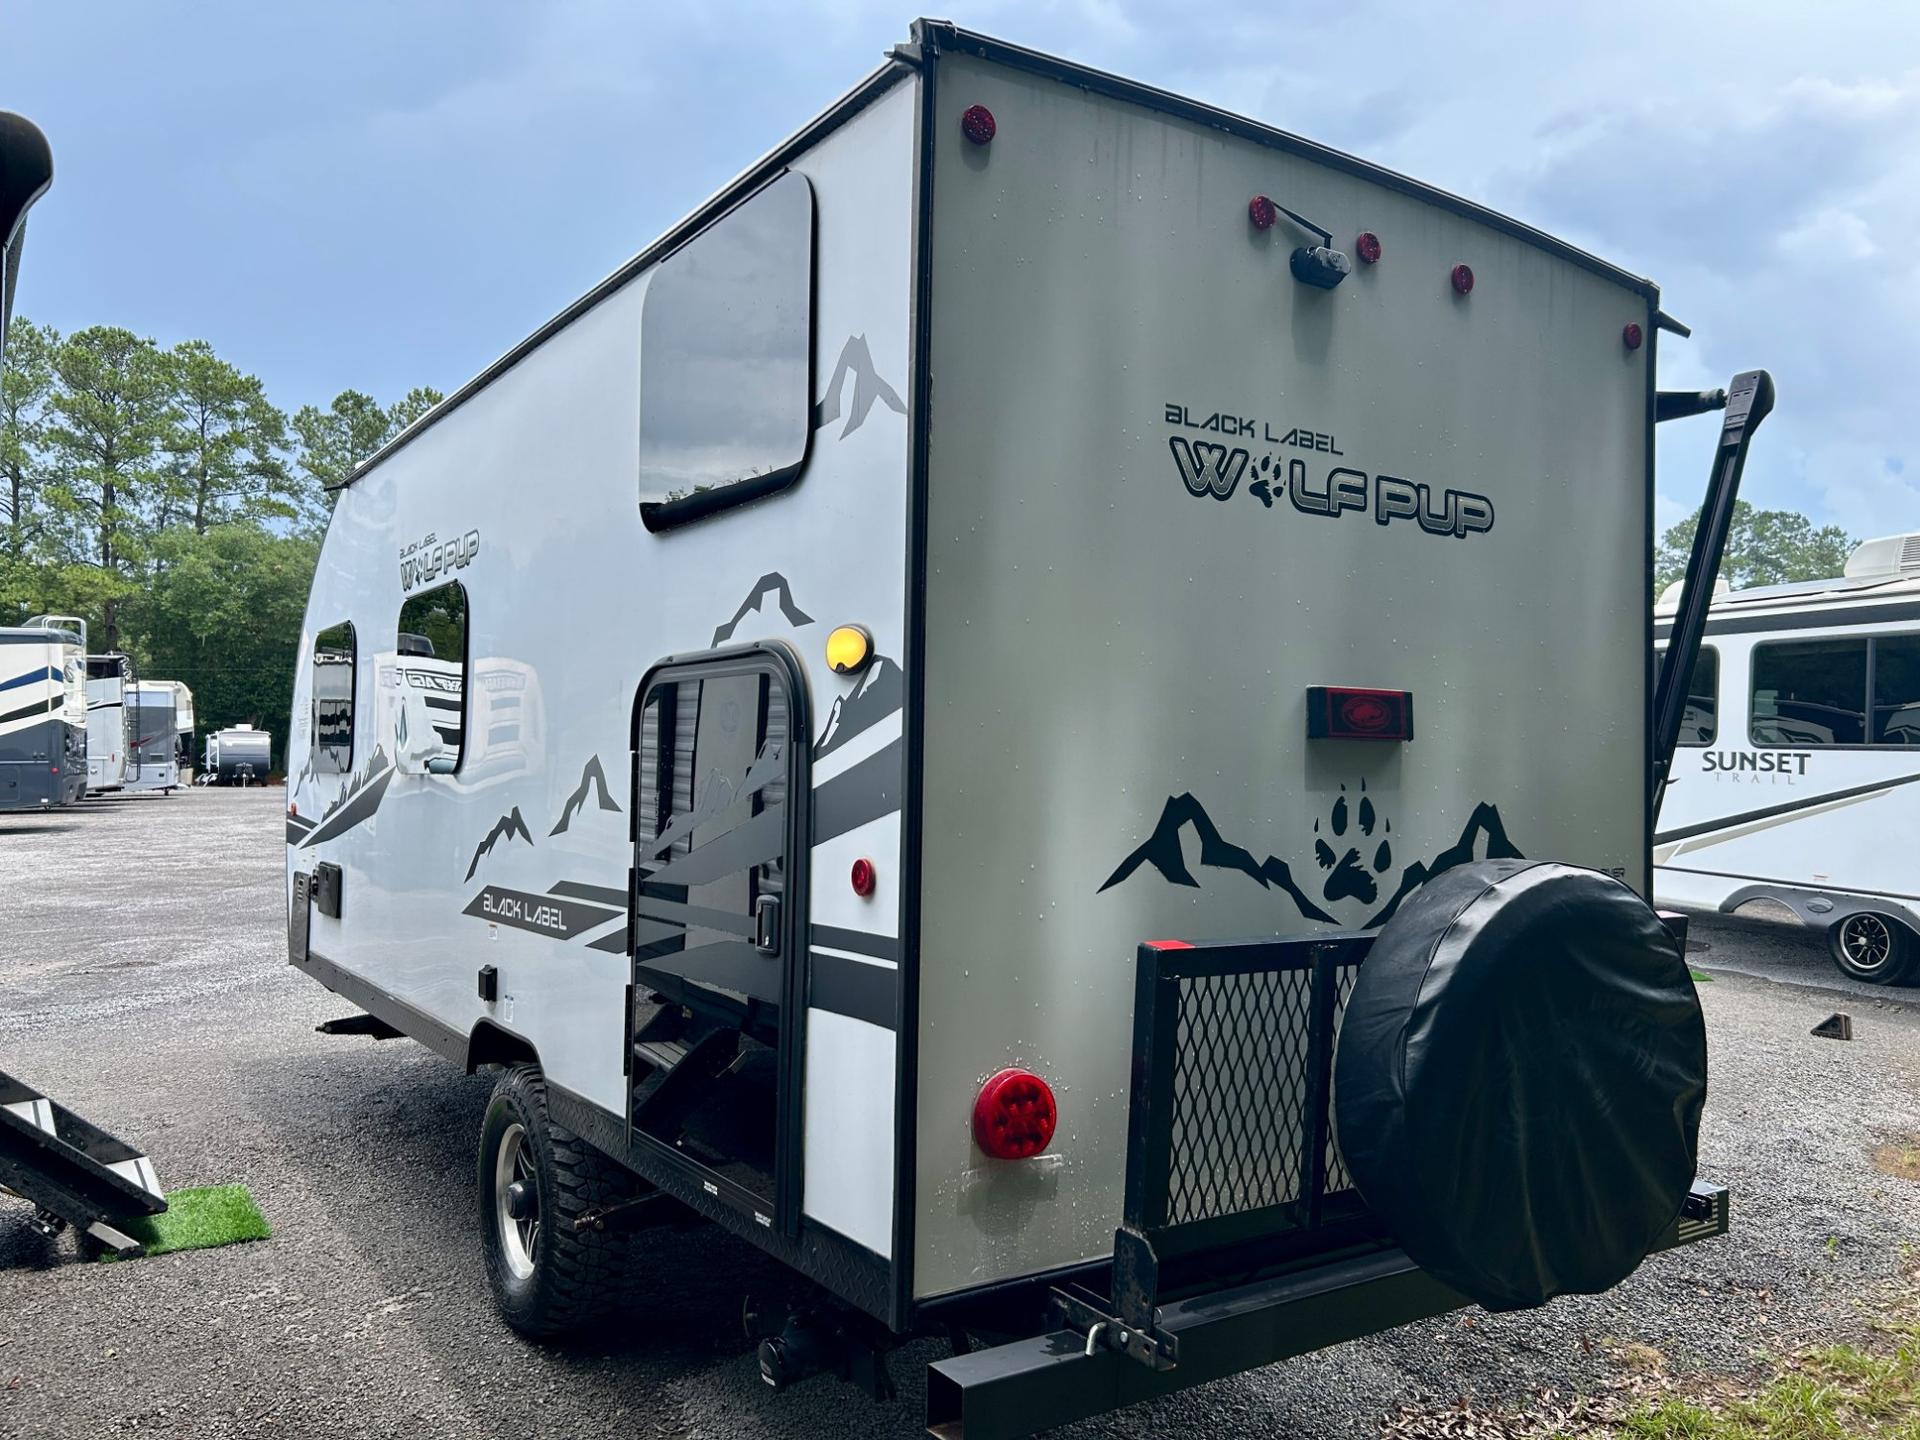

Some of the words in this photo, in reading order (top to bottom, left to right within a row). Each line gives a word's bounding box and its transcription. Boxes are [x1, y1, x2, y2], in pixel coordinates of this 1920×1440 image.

[1165, 403, 1255, 438] BLACK
[1265, 422, 1344, 456] LABEL
[1702, 751, 1812, 775] SUNSET
[1714, 772, 1796, 785] TRAIL
[483, 893, 521, 919] BLACK
[524, 902, 567, 930] LABEL
